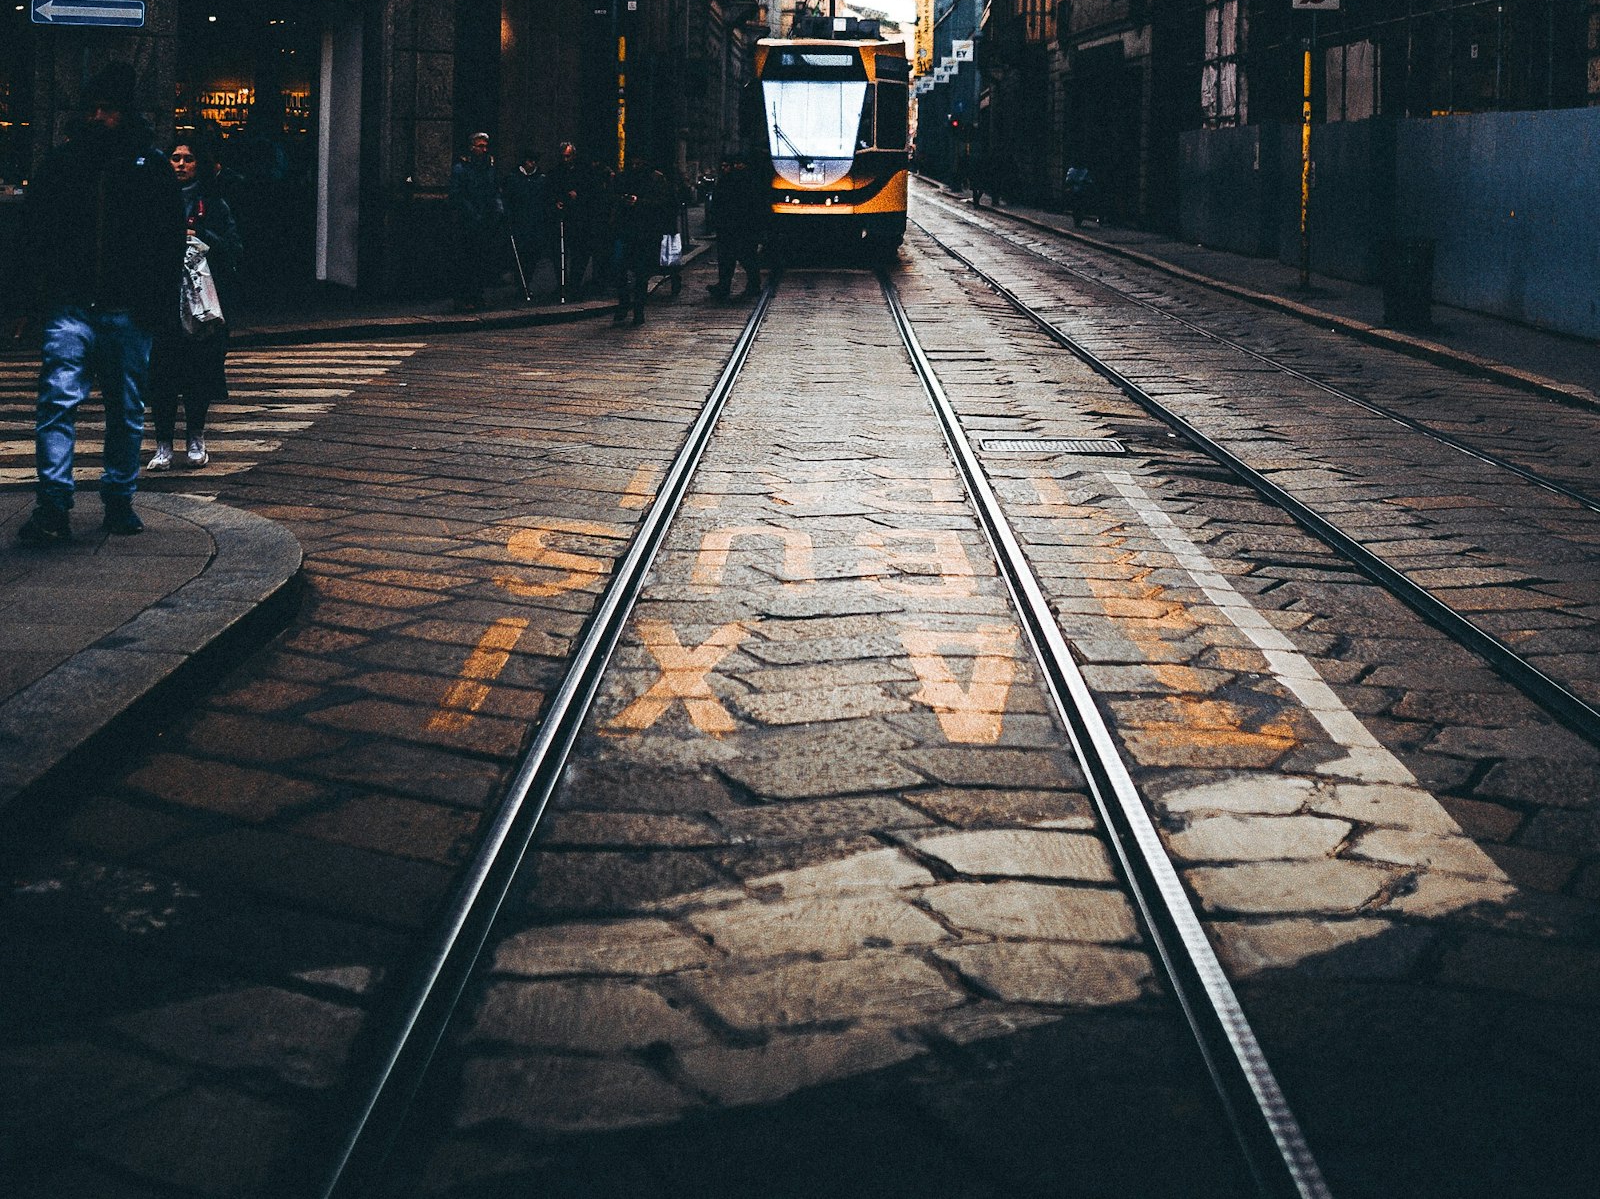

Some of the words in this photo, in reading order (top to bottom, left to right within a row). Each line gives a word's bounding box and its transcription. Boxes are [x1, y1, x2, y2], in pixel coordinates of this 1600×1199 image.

[943, 65, 954, 73] EY
[956, 50, 967, 58] EY
[492, 515, 976, 598] BUS
[424, 609, 1300, 748] TAXI
